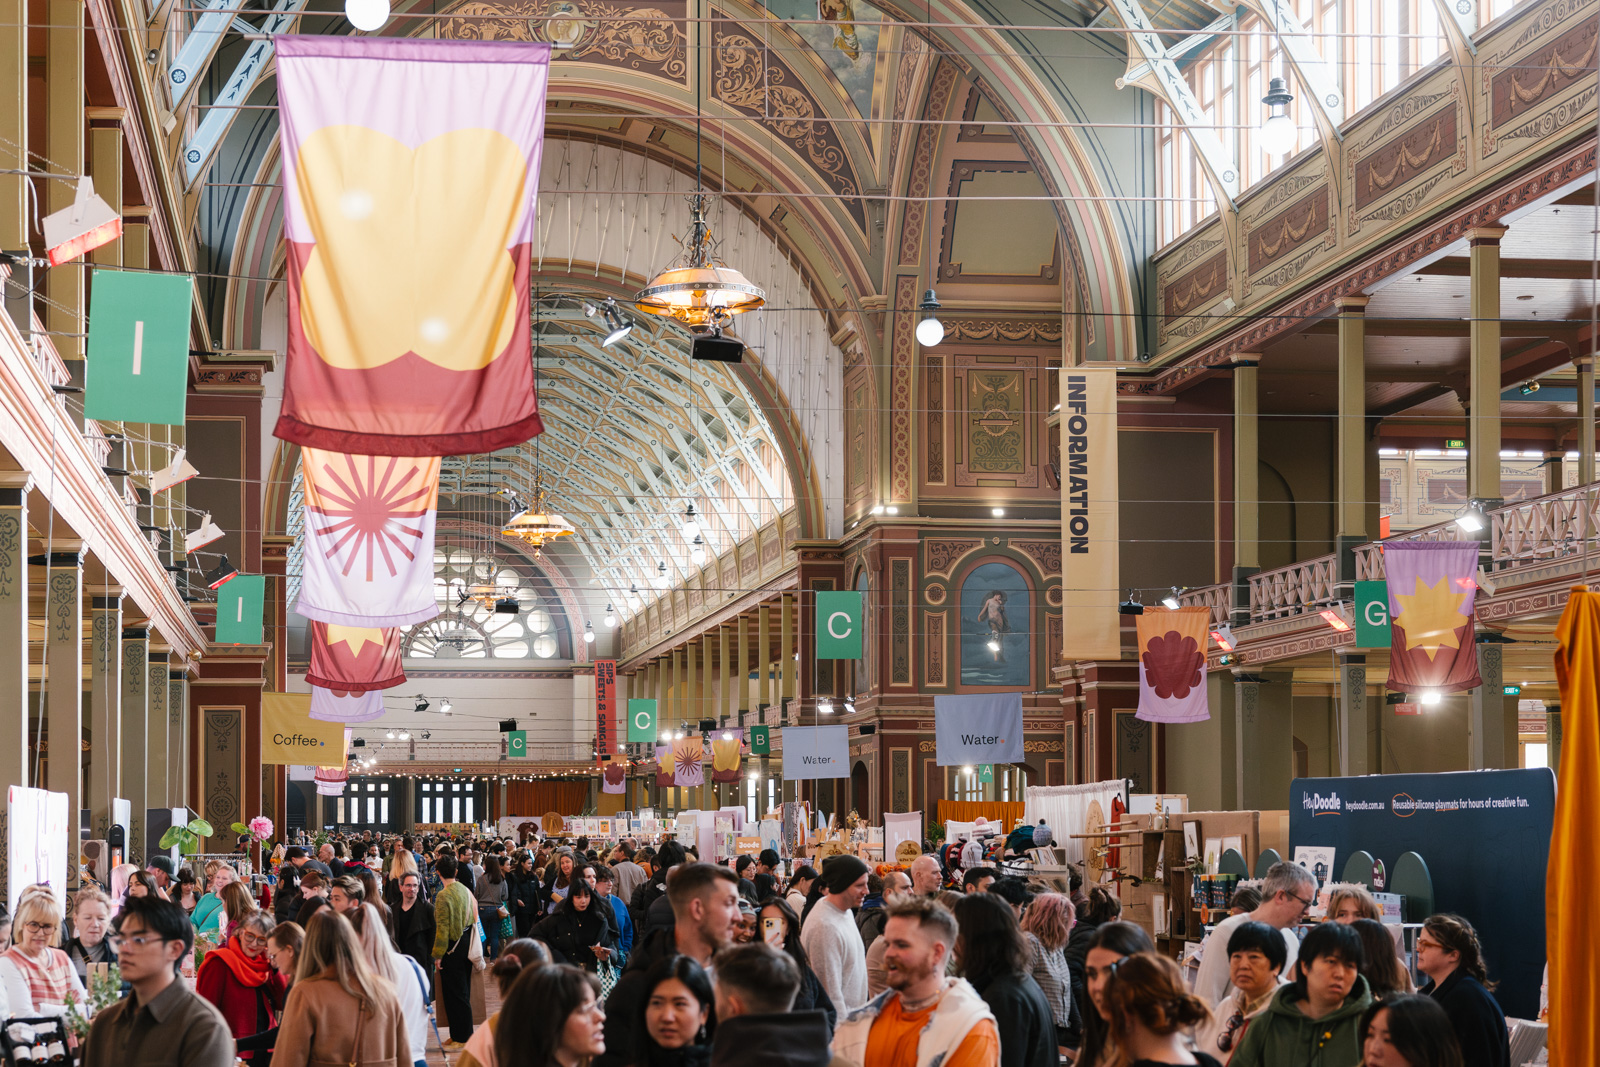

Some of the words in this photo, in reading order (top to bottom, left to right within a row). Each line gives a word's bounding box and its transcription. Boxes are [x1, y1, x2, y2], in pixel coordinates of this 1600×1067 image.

[1067, 375, 1089, 554] INFORMATION
[1364, 600, 1387, 626] G
[827, 611, 852, 639] C
[597, 662, 606, 702] SWEETS
[635, 711, 650, 729] C
[598, 713, 606, 753] SANGAS
[756, 734, 765, 745] B
[512, 737, 523, 749] C
[983, 765, 992, 775] A
[1345, 800, 1385, 812] heydoodle.com.au
[1392, 799, 1415, 809] Reusable
[1415, 799, 1434, 809] silicone
[1435, 799, 1459, 811] playmats
[1460, 798, 1468, 808] for
[1468, 798, 1484, 808] hours
[1485, 797, 1492, 808] of
[1492, 797, 1515, 808] creative
[1516, 796, 1529, 807] fun.
